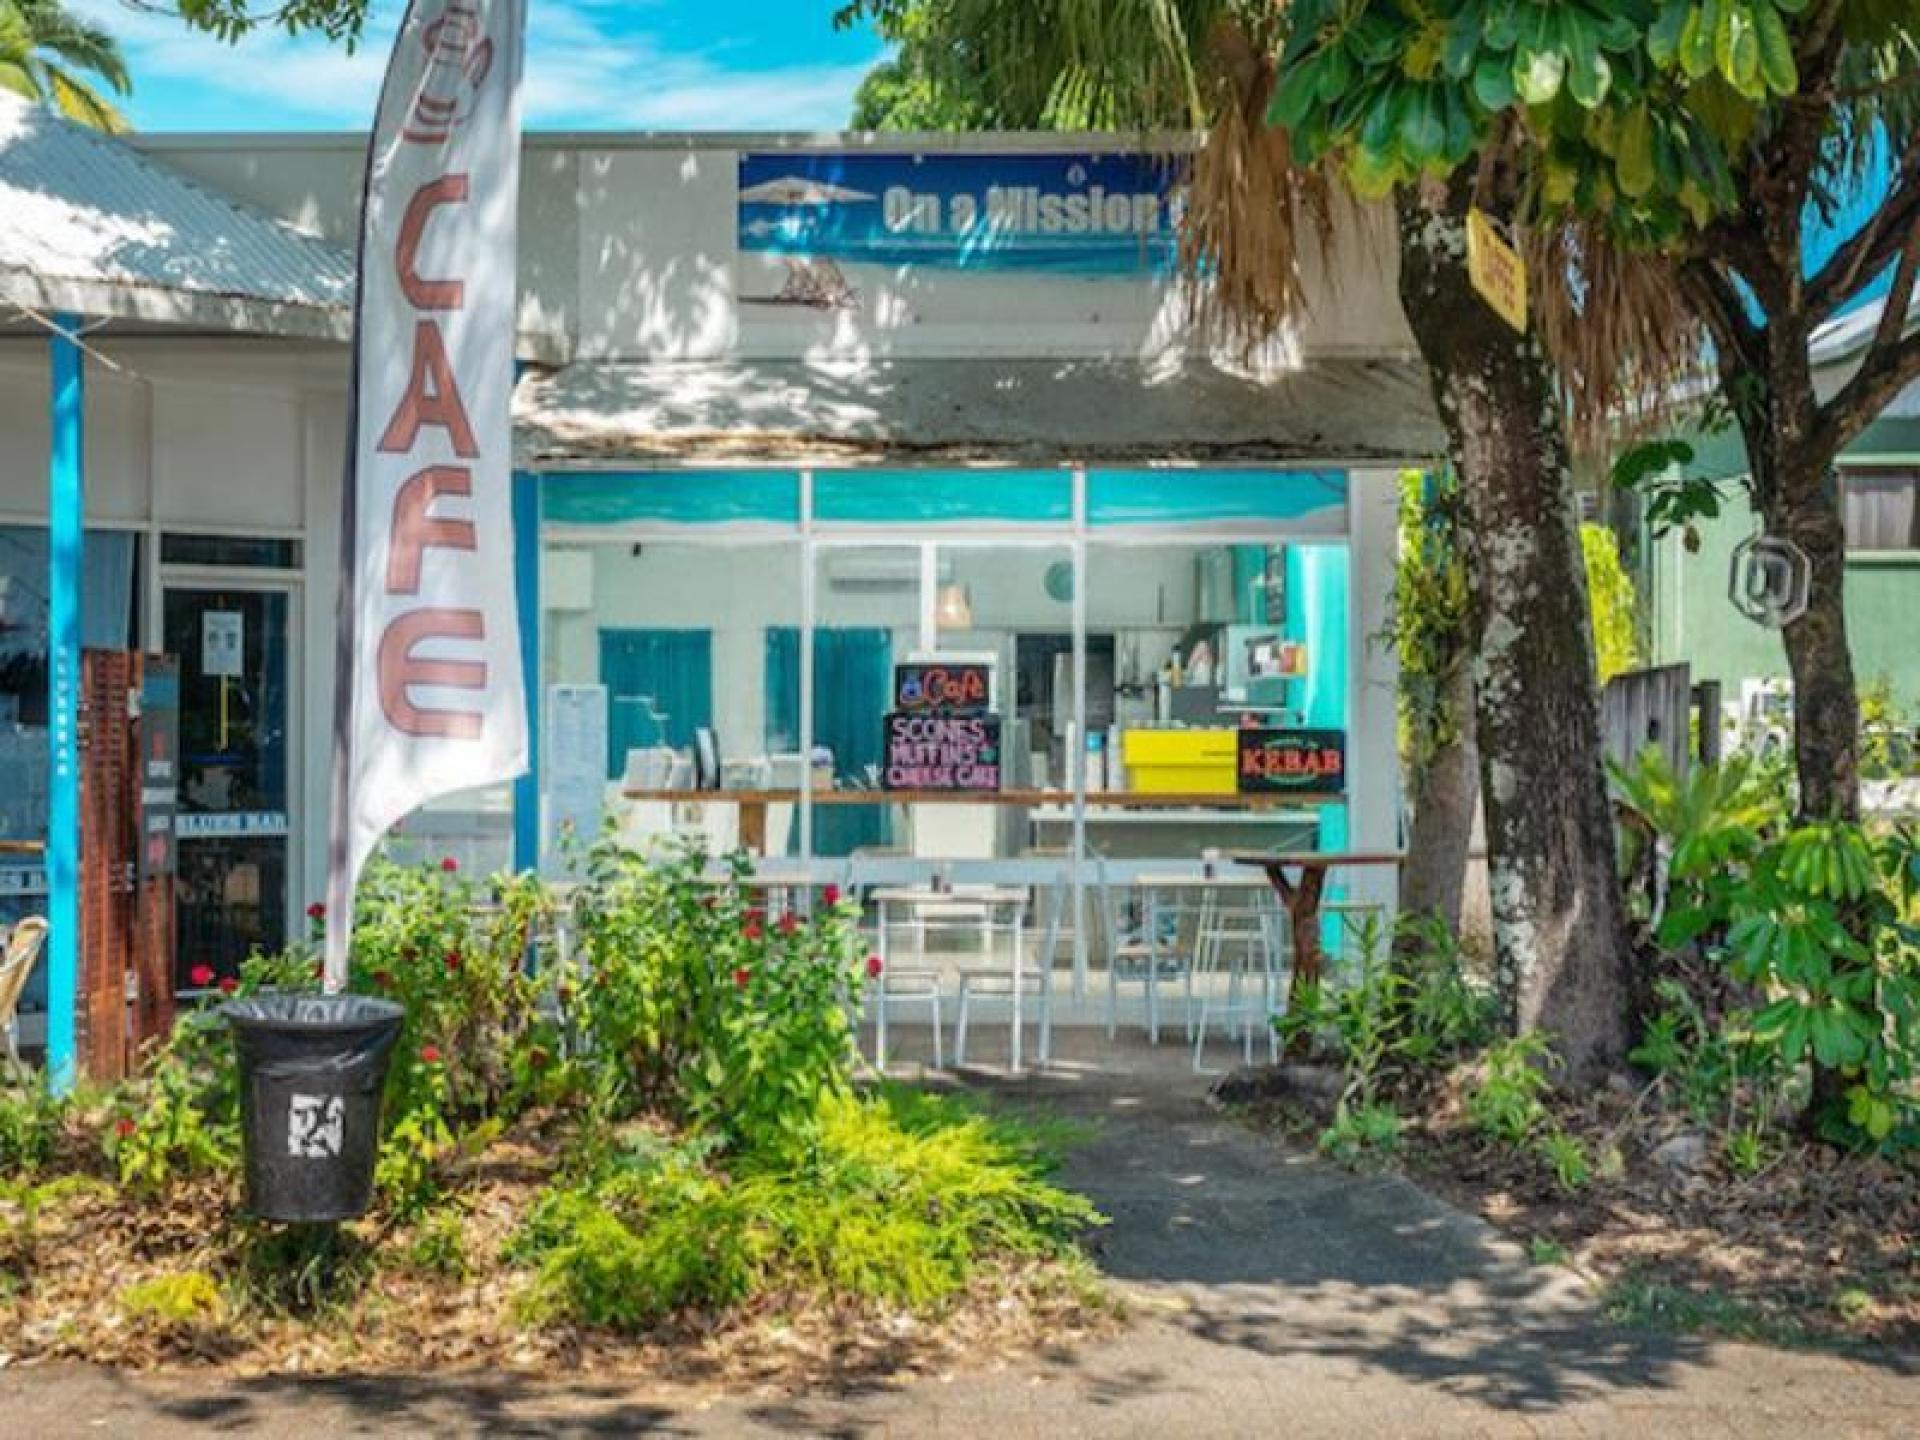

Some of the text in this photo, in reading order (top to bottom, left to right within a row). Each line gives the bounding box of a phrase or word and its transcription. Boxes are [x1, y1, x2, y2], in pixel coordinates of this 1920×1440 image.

[883, 185, 941, 233] On
[949, 193, 977, 233] a
[986, 185, 1159, 233] Mission
[377, 173, 488, 740] CAFE
[892, 718, 986, 742] SCONES
[1241, 748, 1342, 775] KEBAB
